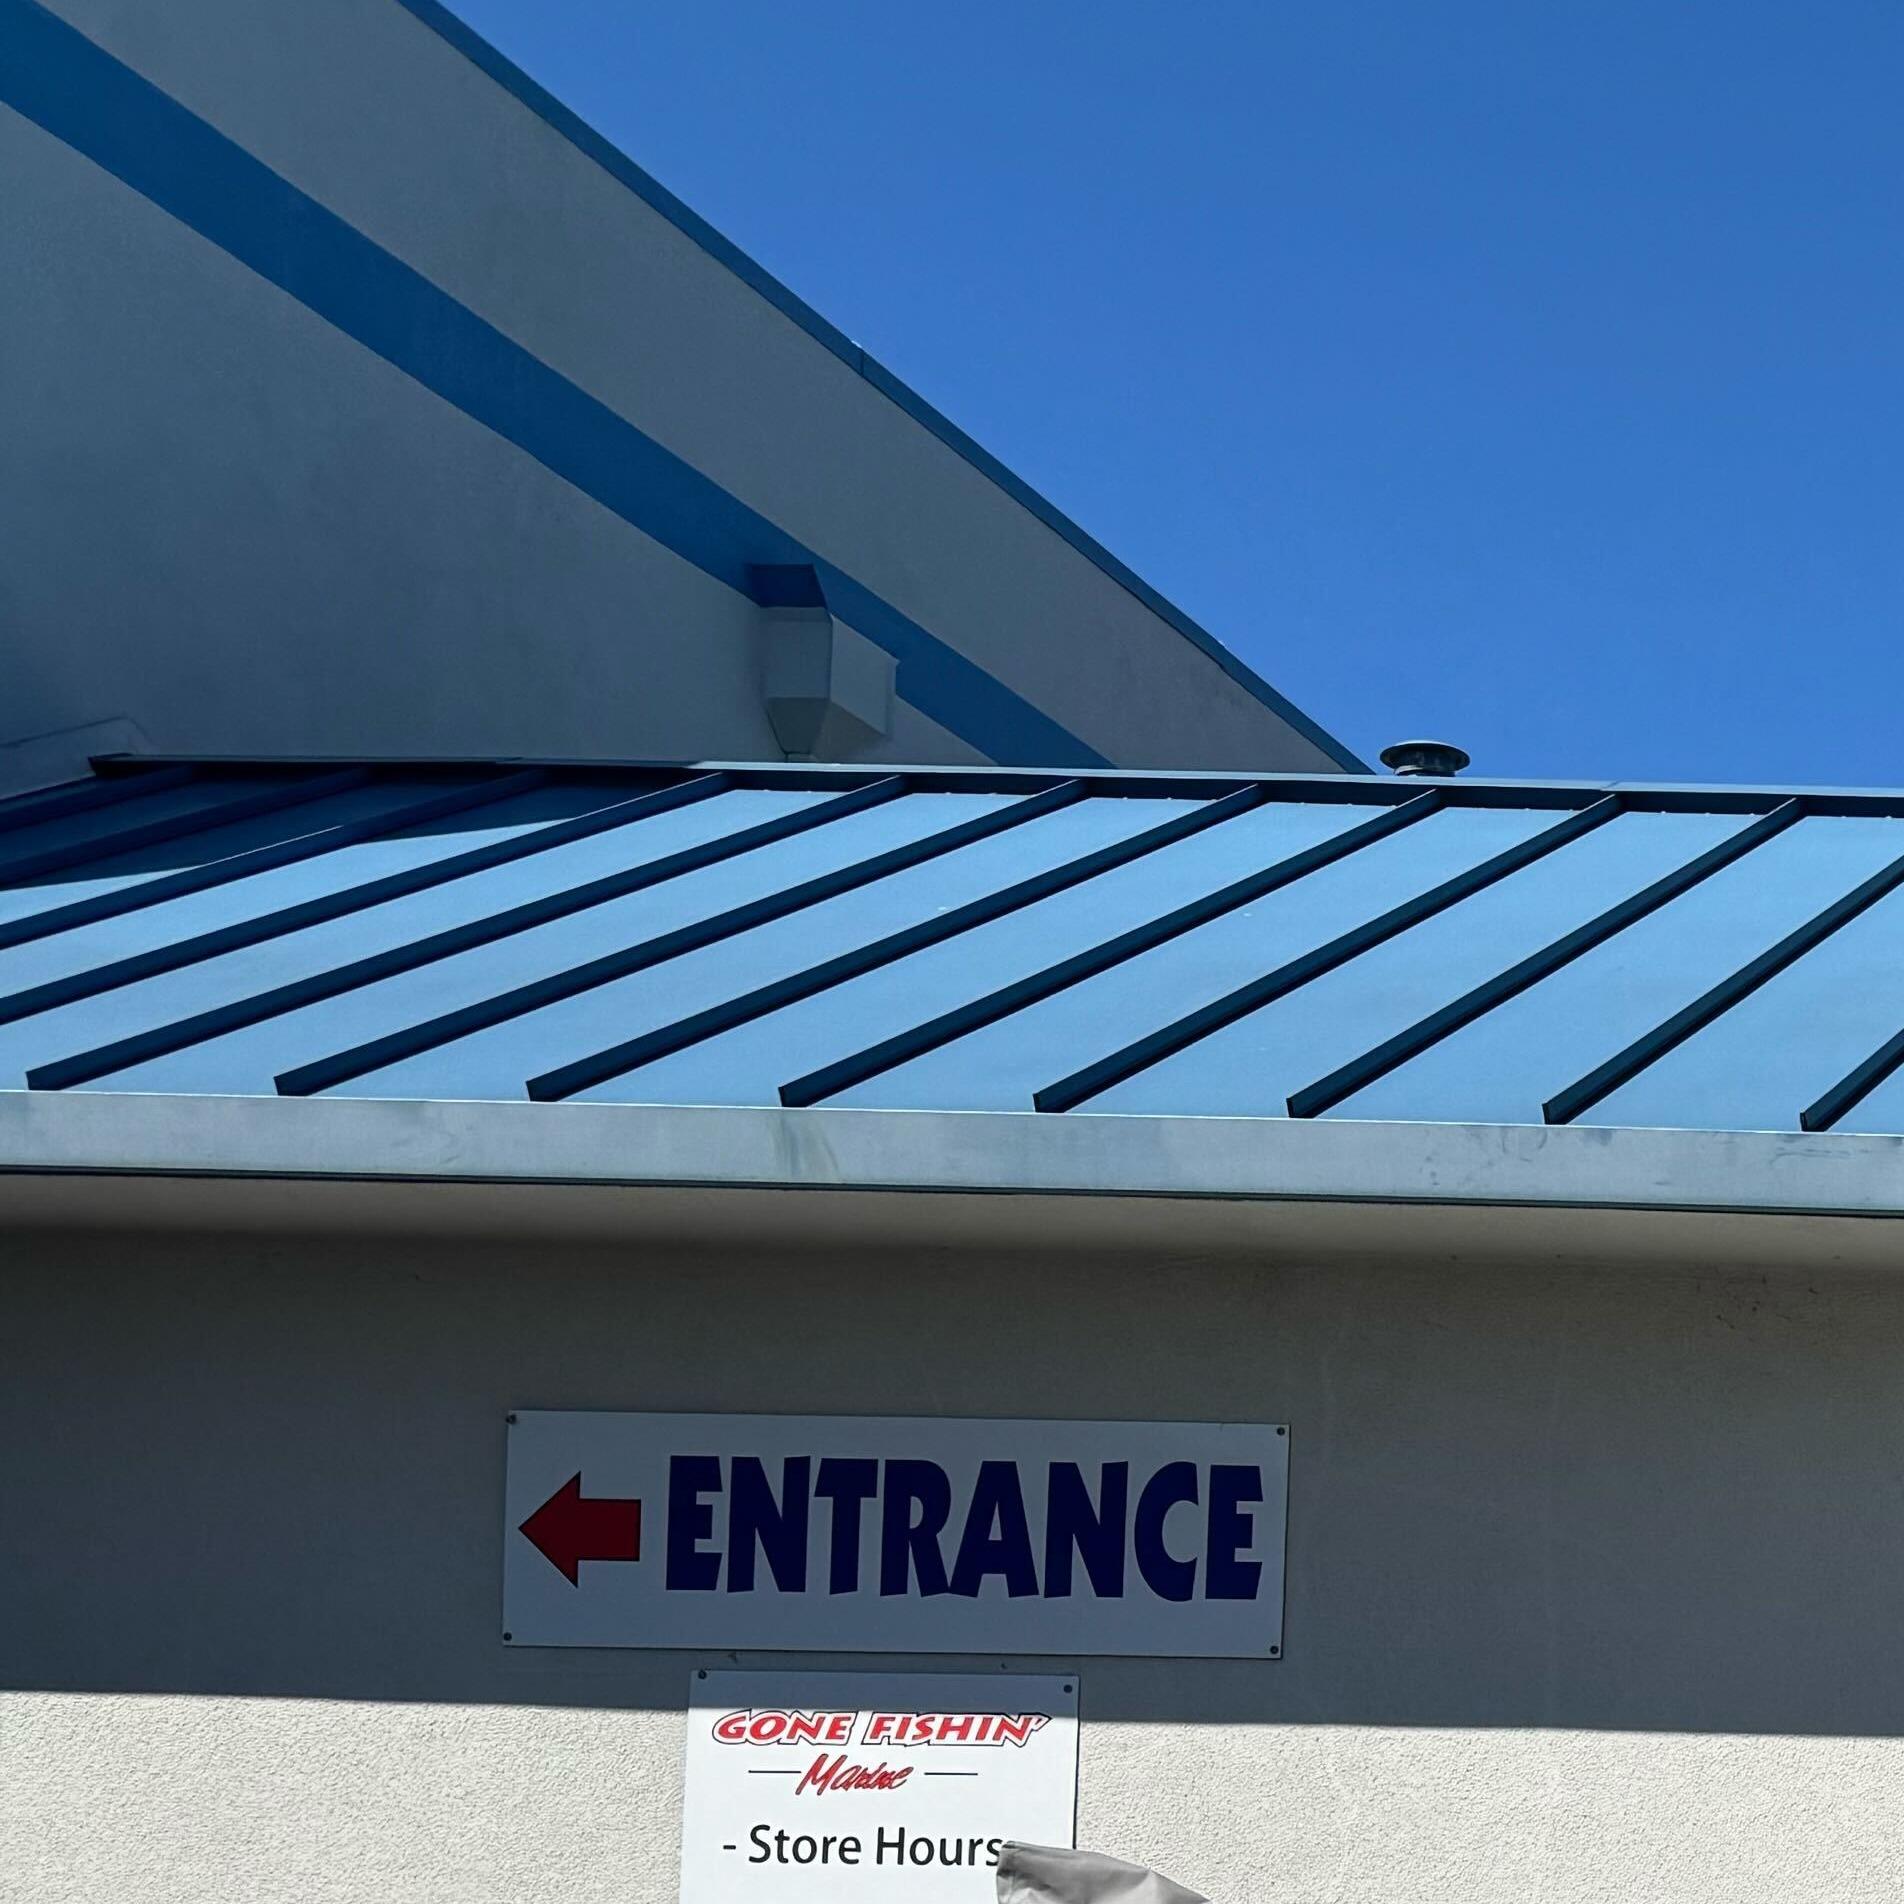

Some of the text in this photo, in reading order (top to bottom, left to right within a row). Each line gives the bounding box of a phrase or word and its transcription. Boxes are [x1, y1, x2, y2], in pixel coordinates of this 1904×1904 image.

[666, 1455, 1263, 1601] ENTRANCE
[713, 1711, 1050, 1746] GONE FISHIN'
[795, 1753, 914, 1796] Marine
[748, 1825, 861, 1864] Store
[876, 1827, 1003, 1866] Hours
